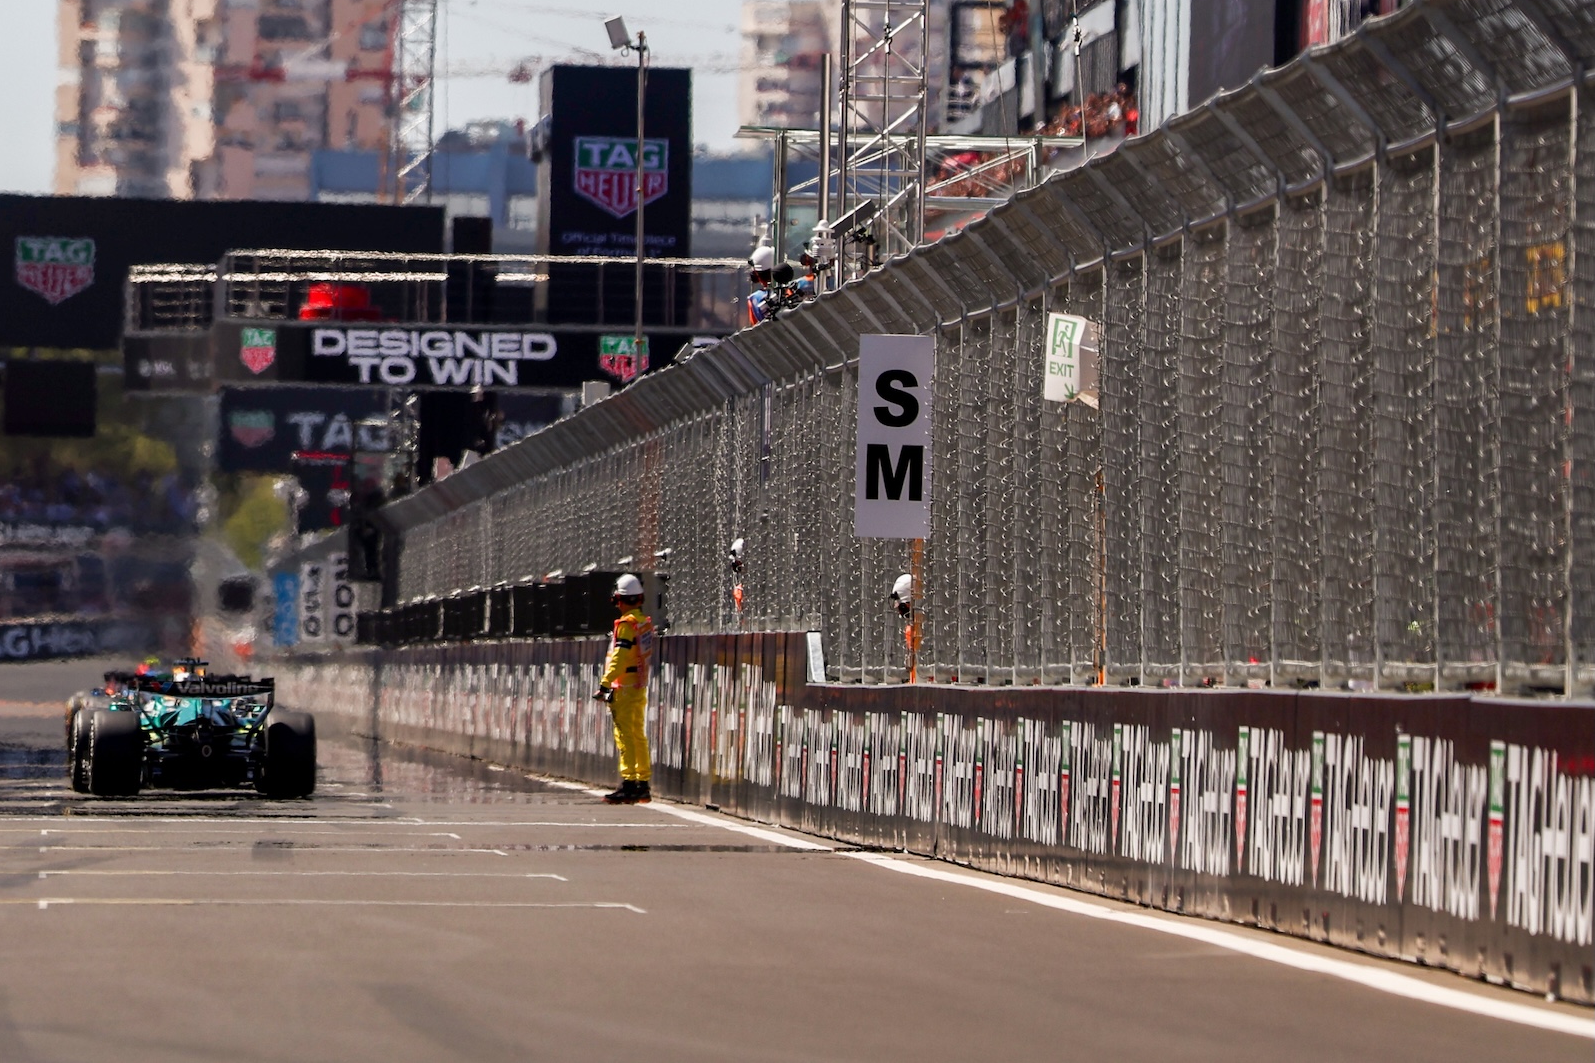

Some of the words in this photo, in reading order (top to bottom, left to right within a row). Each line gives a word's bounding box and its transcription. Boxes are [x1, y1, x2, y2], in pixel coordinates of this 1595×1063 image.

[583, 143, 660, 168] TAG
[26, 240, 88, 264] TAG
[312, 328, 557, 361] DESIGNED
[348, 356, 416, 385] TO
[427, 358, 518, 386] WIN
[1049, 361, 1075, 378] EXIT
[873, 369, 919, 428] S
[865, 443, 924, 502] M
